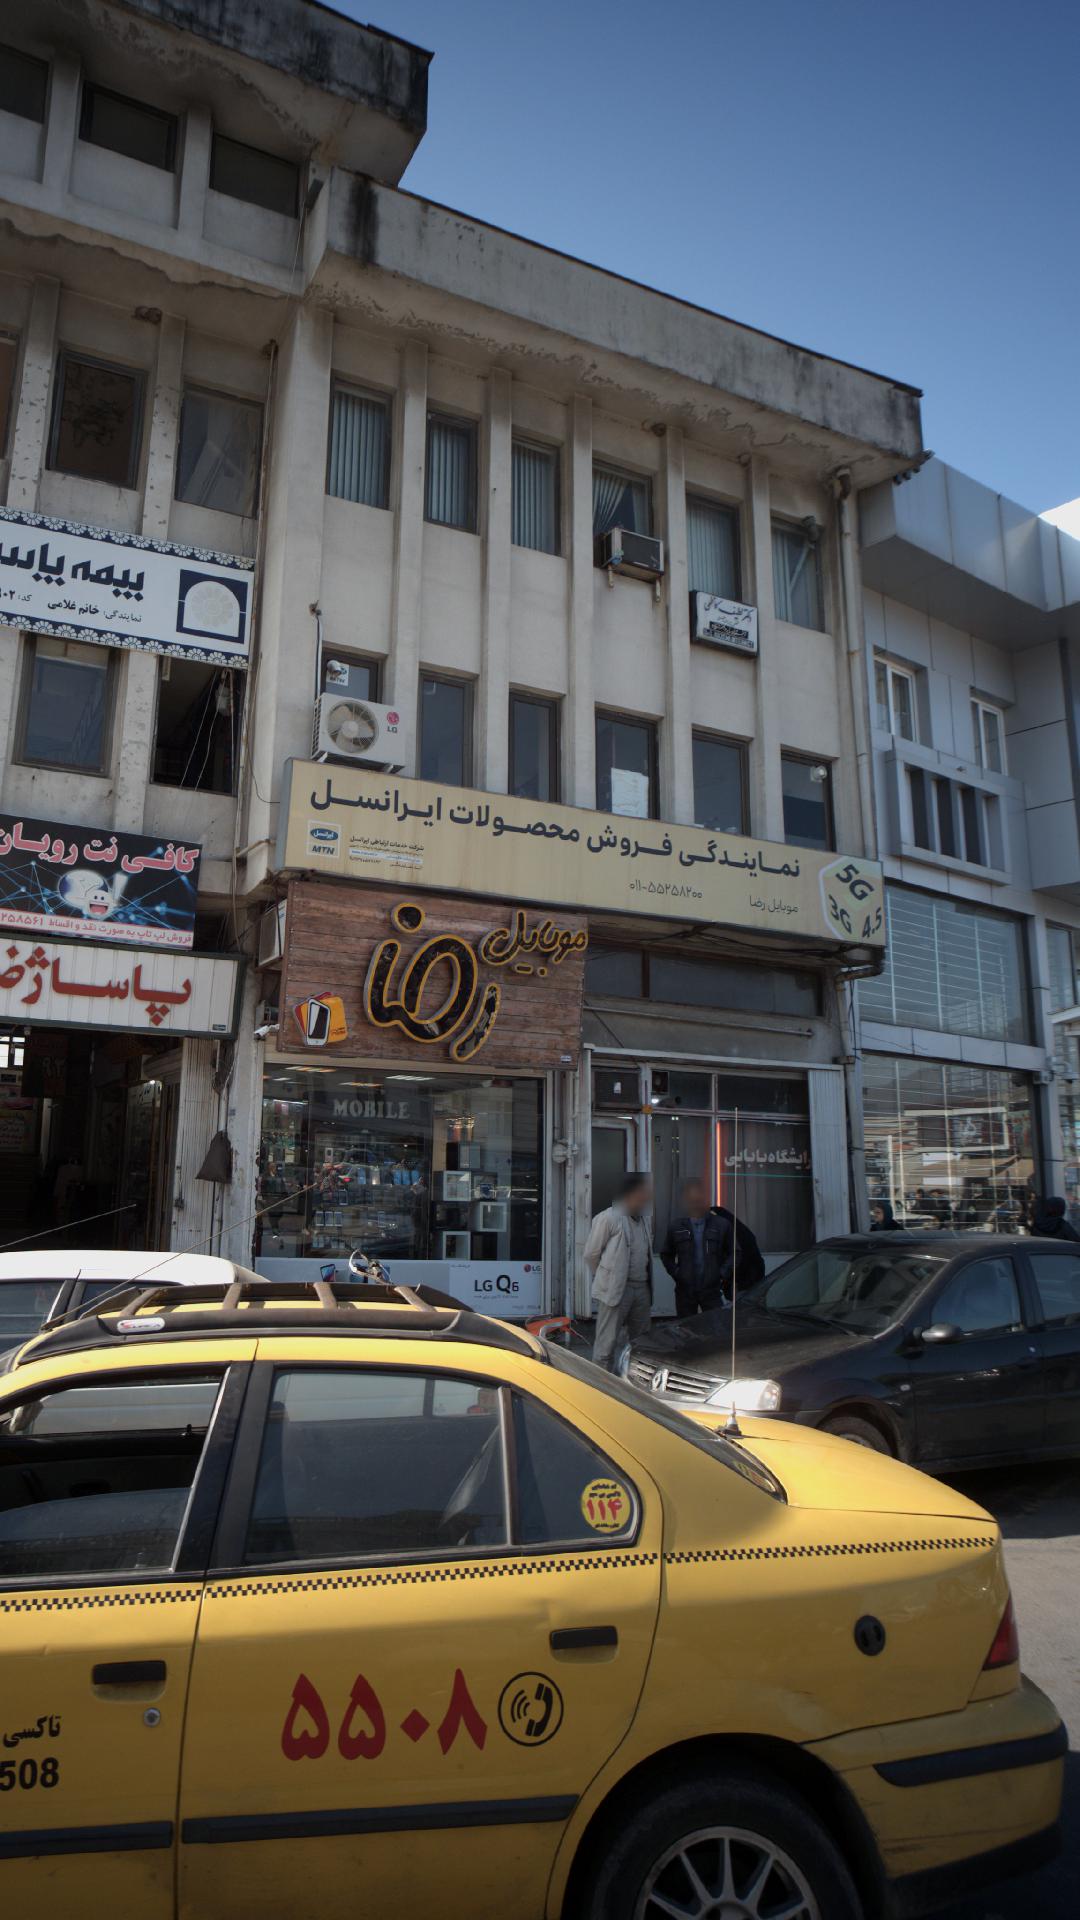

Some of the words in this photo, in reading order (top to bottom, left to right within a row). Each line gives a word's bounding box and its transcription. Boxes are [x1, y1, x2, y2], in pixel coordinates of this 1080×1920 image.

[71, 560, 145, 602] بیمه
[47, 599, 76, 610] غلامی
[79, 603, 100, 615] خانم
[310, 779, 443, 827] ایرانسل
[449, 804, 580, 842] محصولات
[83, 836, 119, 863] نت
[311, 844, 336, 856] MTN
[587, 825, 673, 858] فروش
[121, 842, 200, 874] کافی
[679, 839, 800, 878] نمایندگی
[835, 864, 875, 901] 5G
[749, 895, 766, 911] رضا
[767, 898, 799, 915] موبایل
[828, 894, 853, 935] 3G
[82, 922, 97, 931] نقد
[167, 932, 192, 943] فروش
[480, 908, 588, 977] موبایل
[21, 945, 192, 1026] پاساژ
[332, 1098, 410, 1119] MOBILE
[474, 1279, 493, 1292] LG
[496, 1274, 520, 1294] Q6
[587, 1498, 623, 1521] ۱۱۴
[2, 1713, 62, 1748] تاکسی
[280, 1668, 488, 1762] ۵۵۰۸
